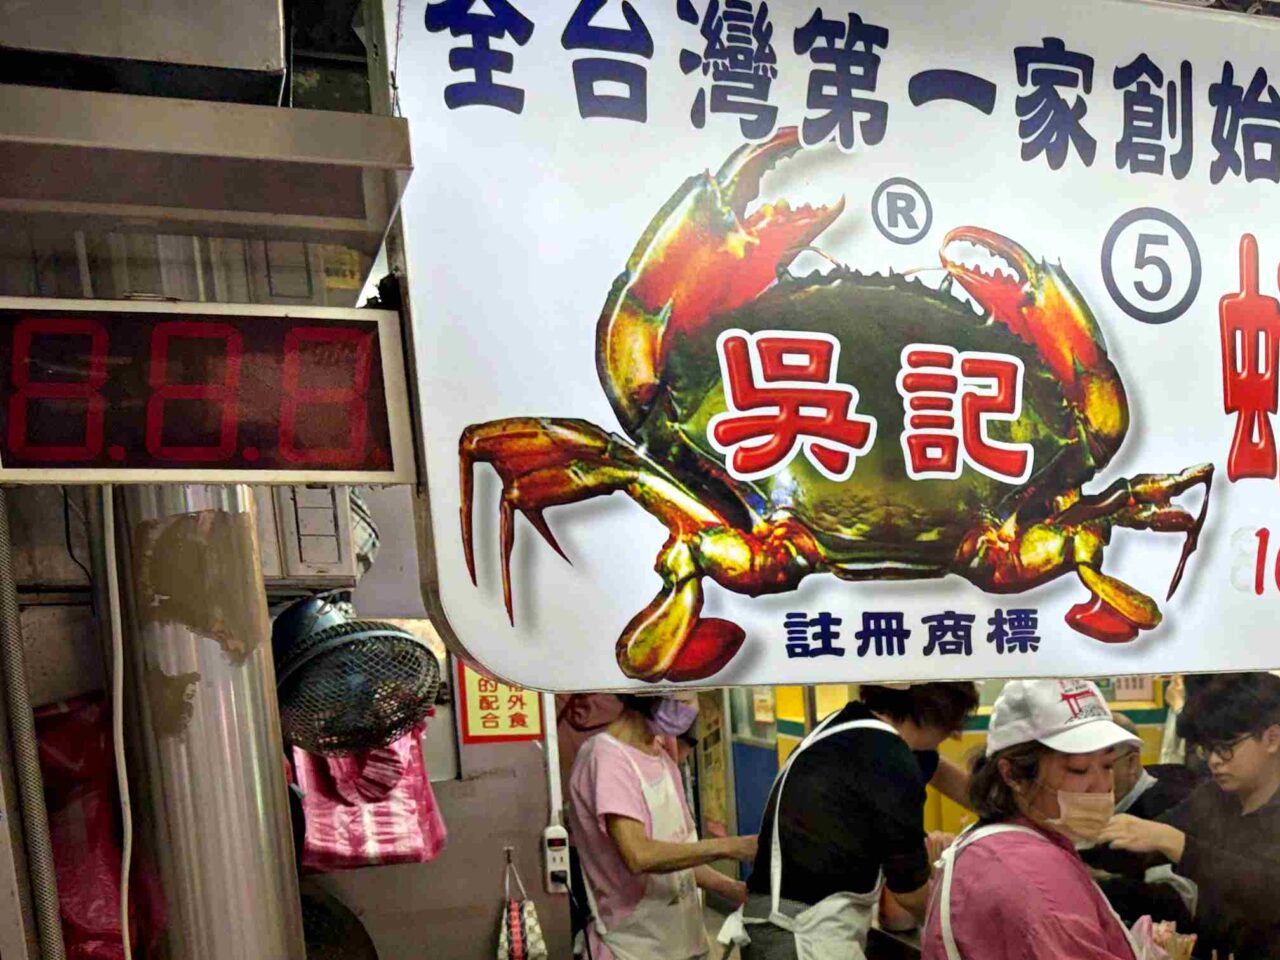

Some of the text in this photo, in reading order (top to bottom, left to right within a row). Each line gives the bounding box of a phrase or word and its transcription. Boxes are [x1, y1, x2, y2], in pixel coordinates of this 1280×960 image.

[711, 333, 1031, 482] 吳記
[783, 608, 1041, 658] 註冊商標
